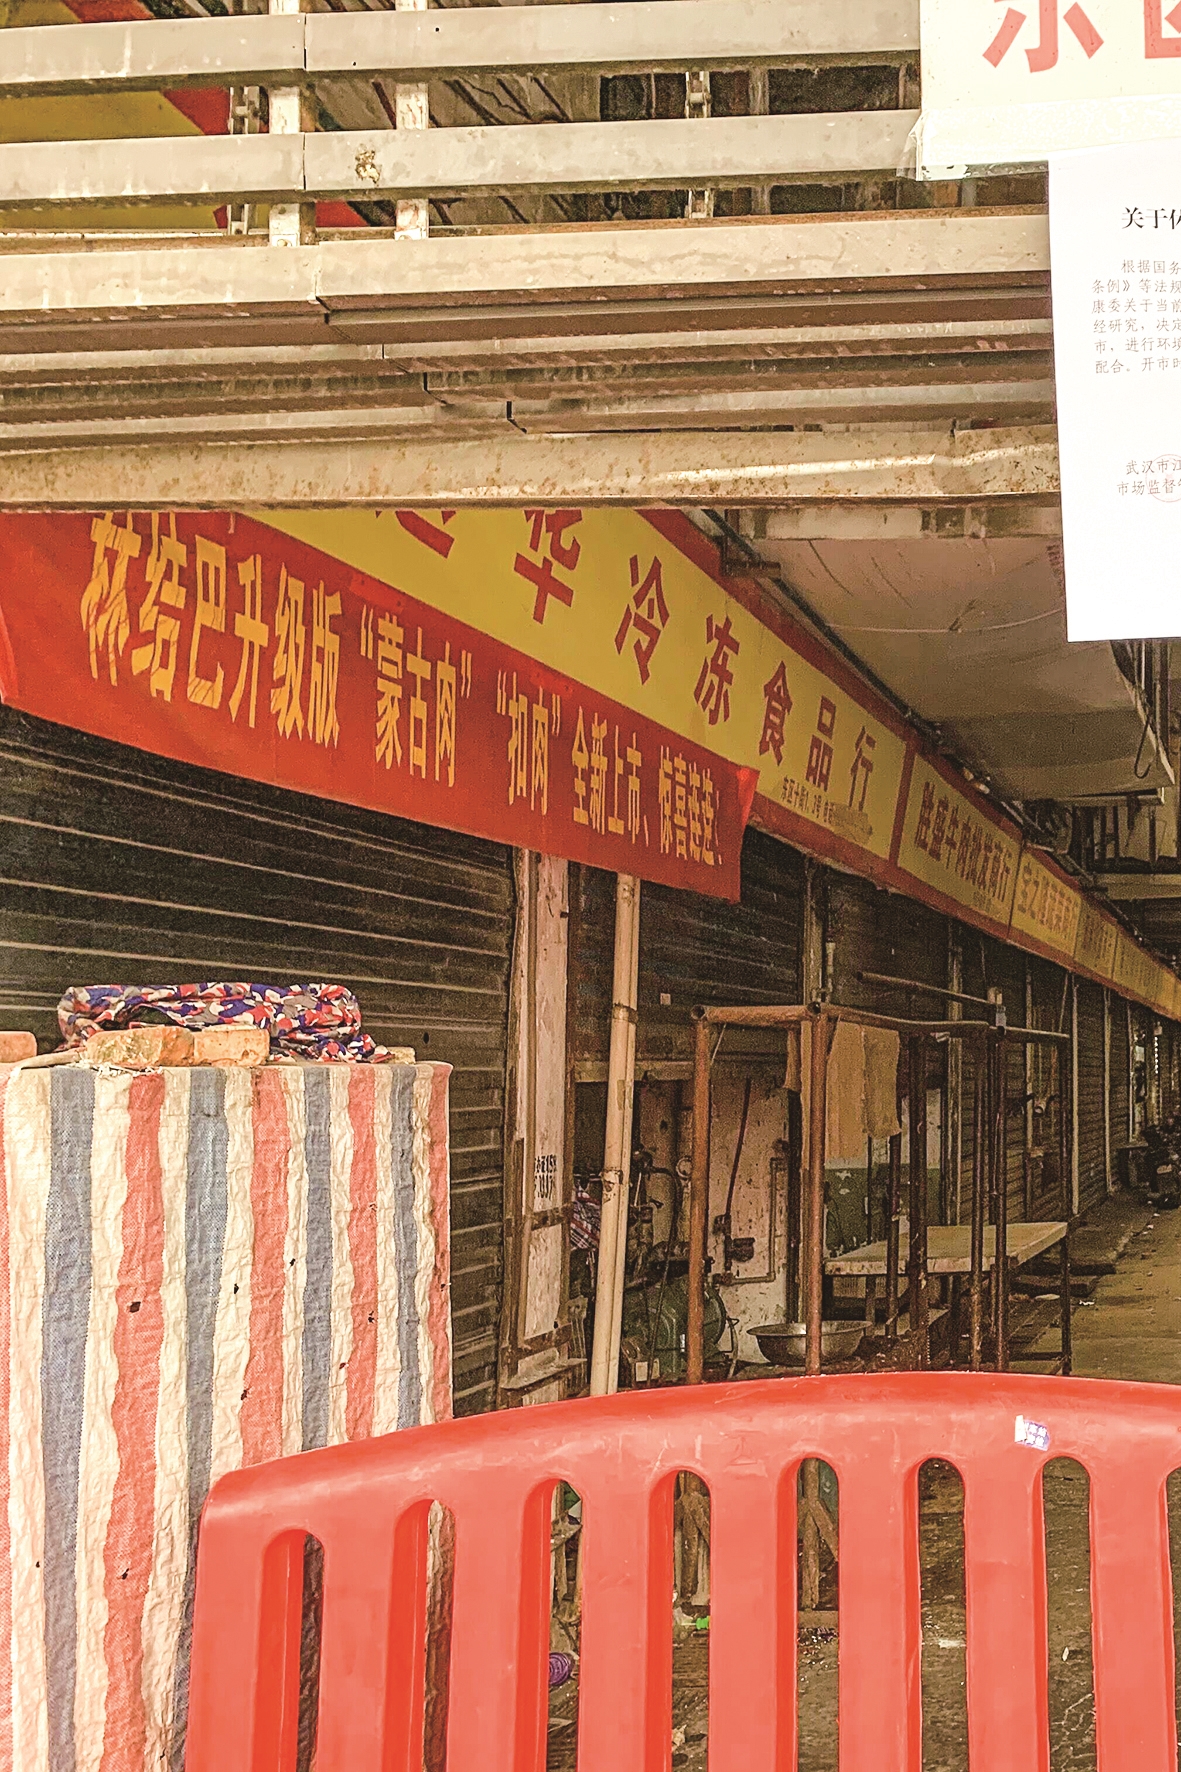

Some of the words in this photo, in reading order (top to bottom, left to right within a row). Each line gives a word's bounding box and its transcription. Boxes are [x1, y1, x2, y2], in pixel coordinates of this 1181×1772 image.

[376, 510, 876, 811] 华冷冻食品行
